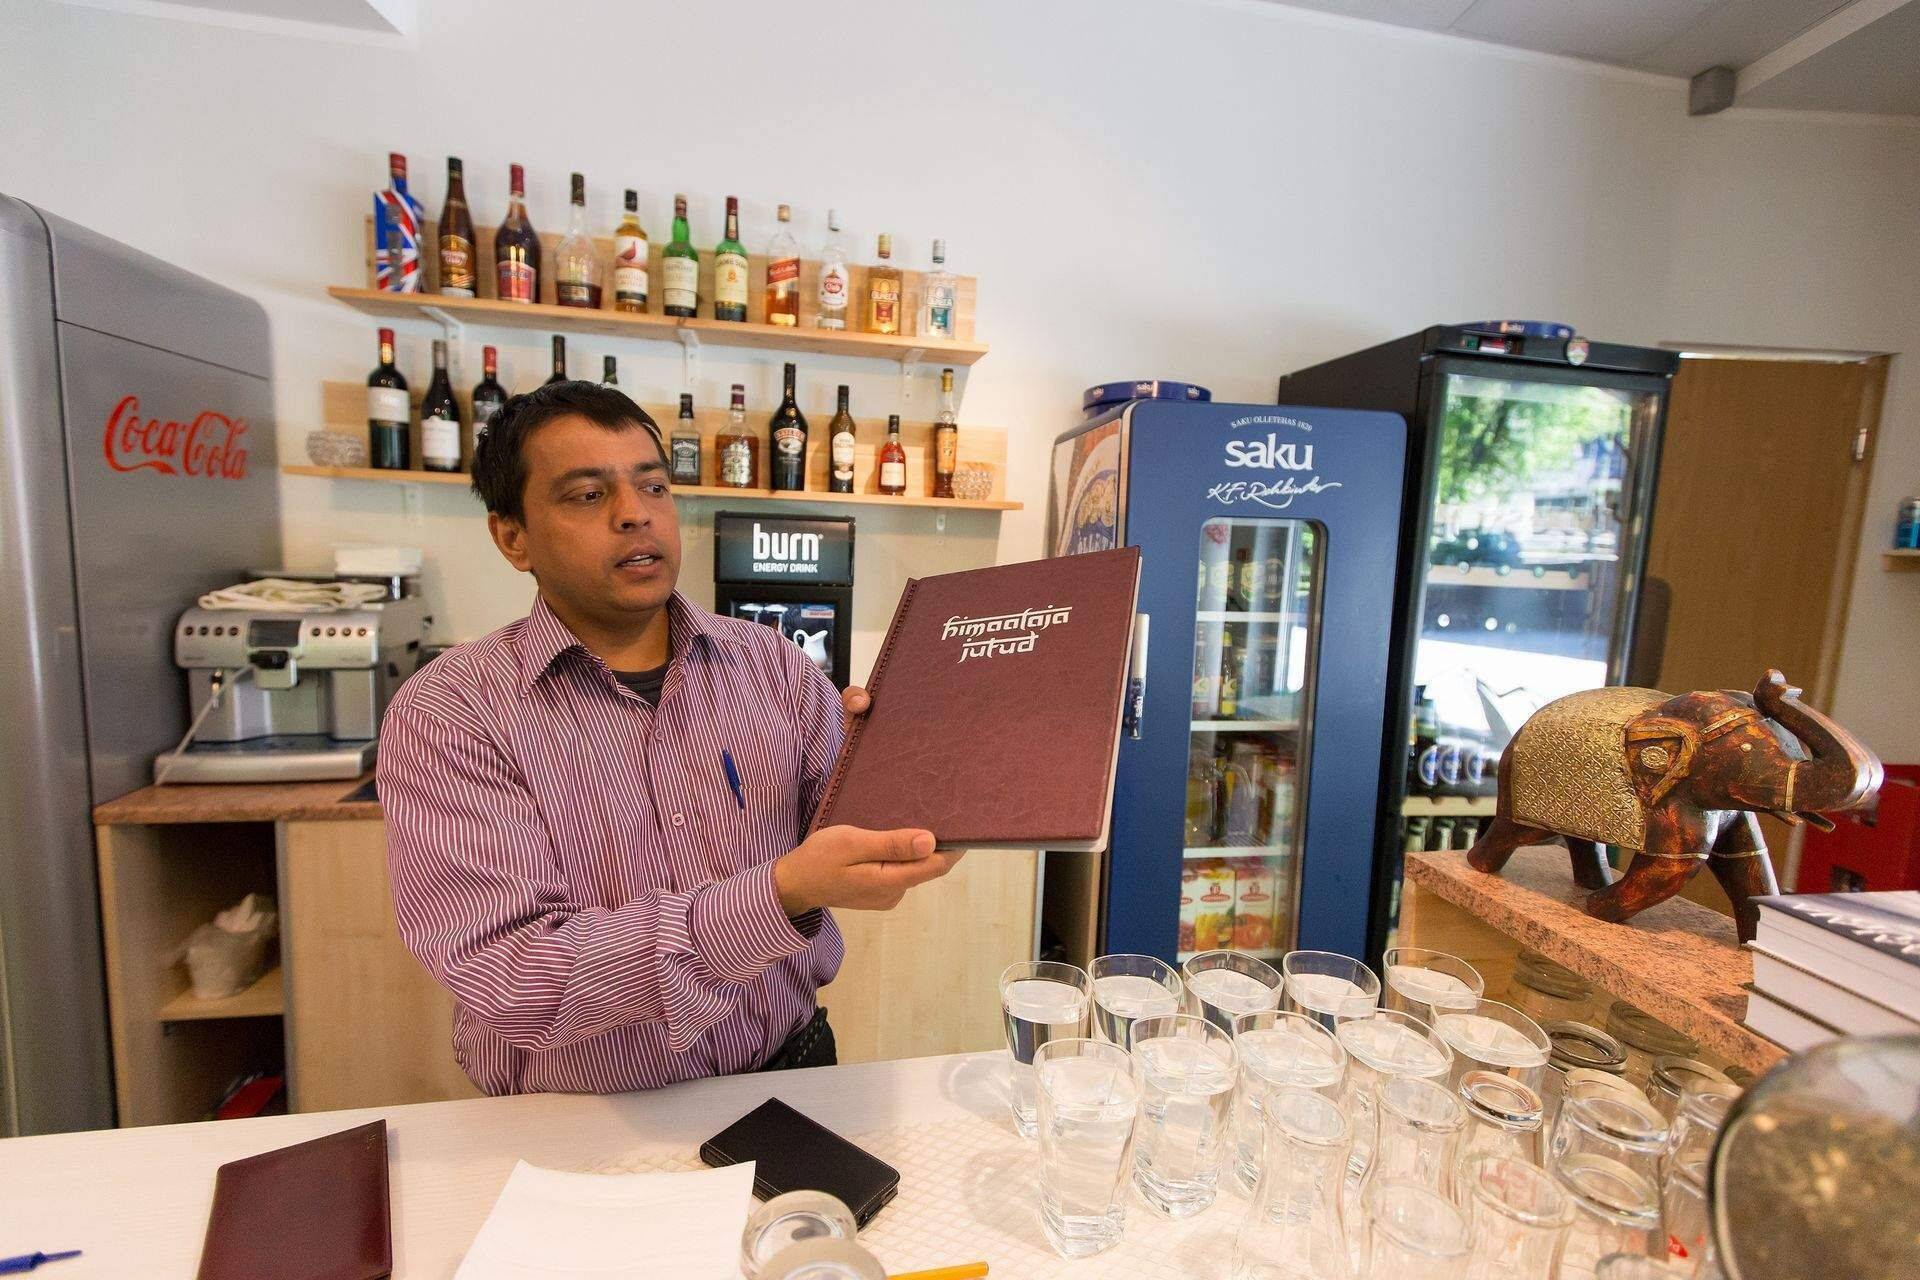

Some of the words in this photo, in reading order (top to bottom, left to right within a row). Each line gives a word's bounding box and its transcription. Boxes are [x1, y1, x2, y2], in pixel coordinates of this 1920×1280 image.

[103, 394, 248, 480] Coca-Cola
[1230, 416, 1253, 429] SAKU
[1225, 433, 1313, 471] saku
[753, 523, 820, 561] burn
[753, 562, 789, 573] ENERGY
[789, 563, 818, 574] DRINK
[940, 604, 1073, 641] himaalaja
[957, 631, 1039, 664] jutud
